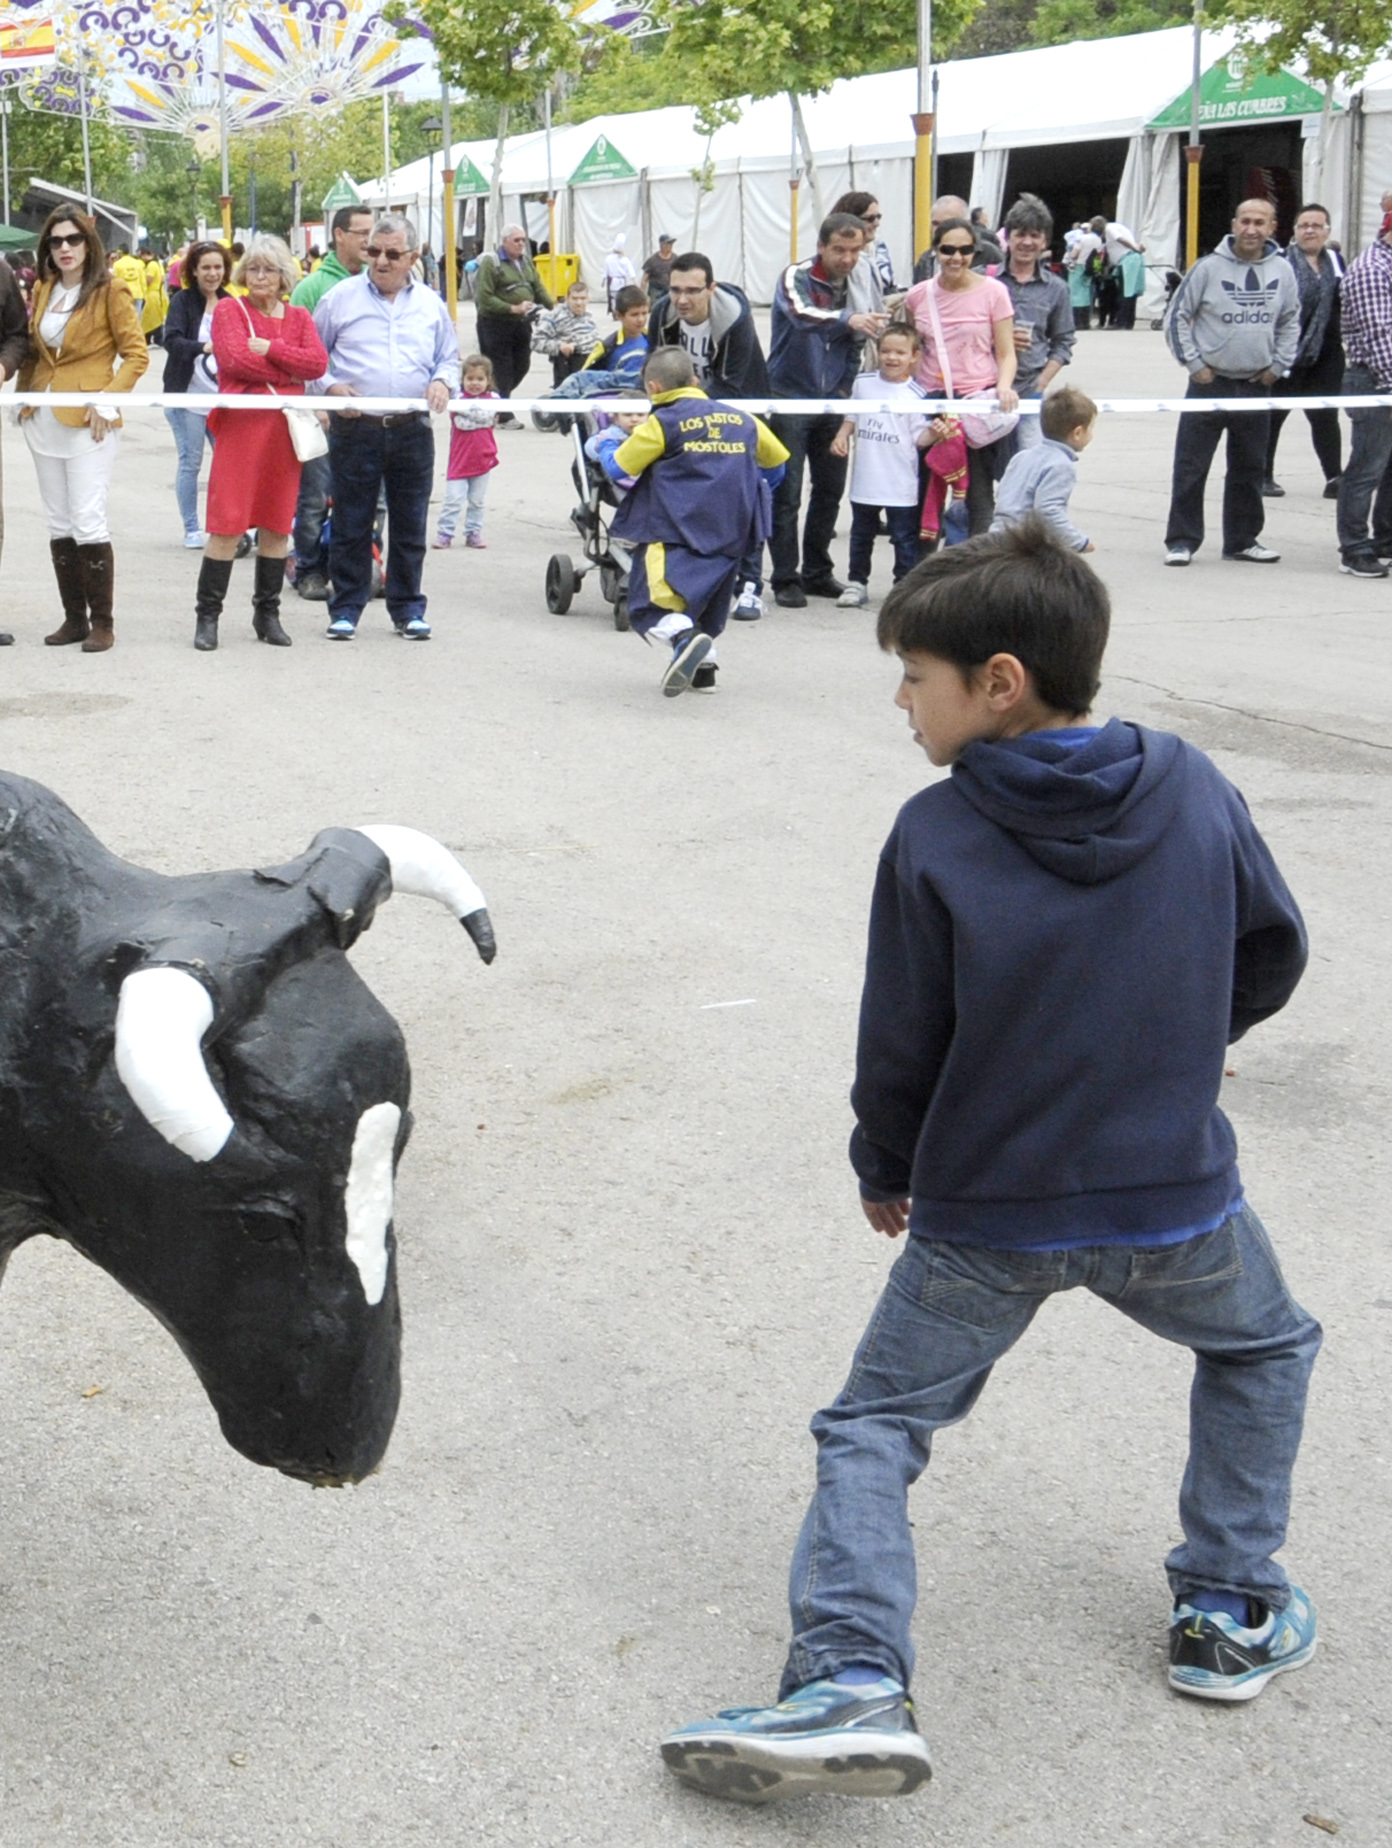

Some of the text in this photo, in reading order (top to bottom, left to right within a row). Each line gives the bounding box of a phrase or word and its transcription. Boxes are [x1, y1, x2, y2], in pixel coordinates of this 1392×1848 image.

[1199, 100, 1217, 120] EÑA
[679, 416, 704, 432] LOS
[708, 427, 722, 439] DE
[858, 427, 900, 444] mirates
